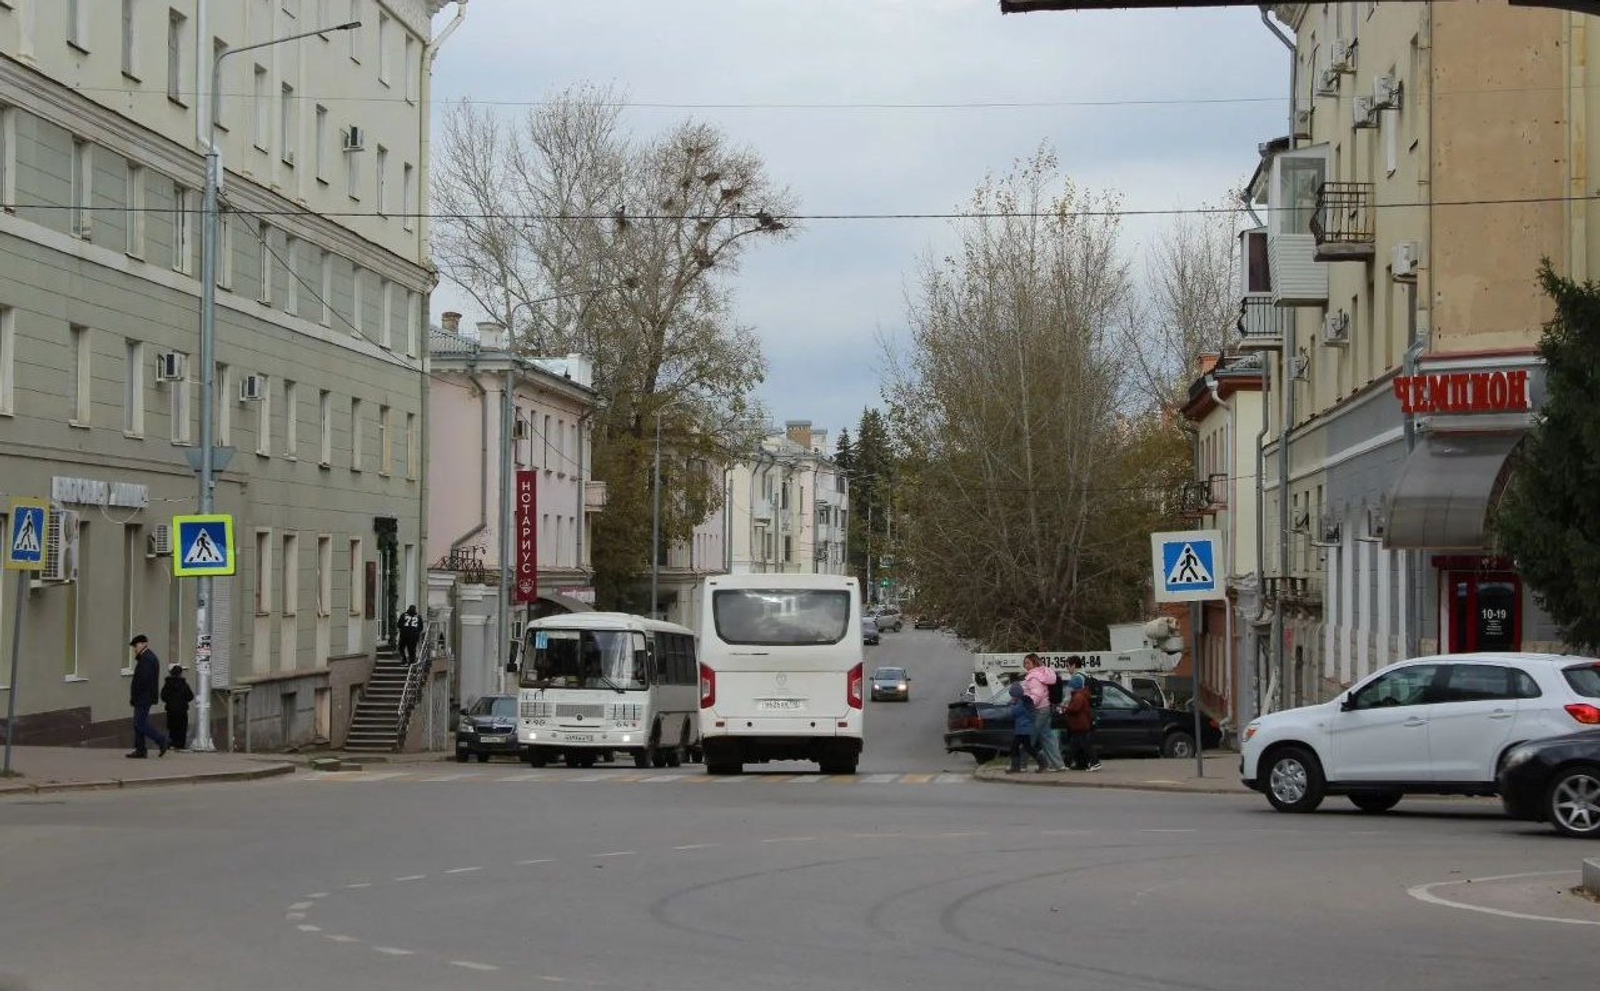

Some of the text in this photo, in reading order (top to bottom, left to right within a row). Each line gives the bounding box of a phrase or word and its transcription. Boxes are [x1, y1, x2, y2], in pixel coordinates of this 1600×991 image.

[1393, 370, 1528, 413] ЧЕМПИОН
[521, 481, 531, 573] НОТАРИУС
[403, 615, 418, 628] 72
[1481, 608, 1507, 620] 10-19
